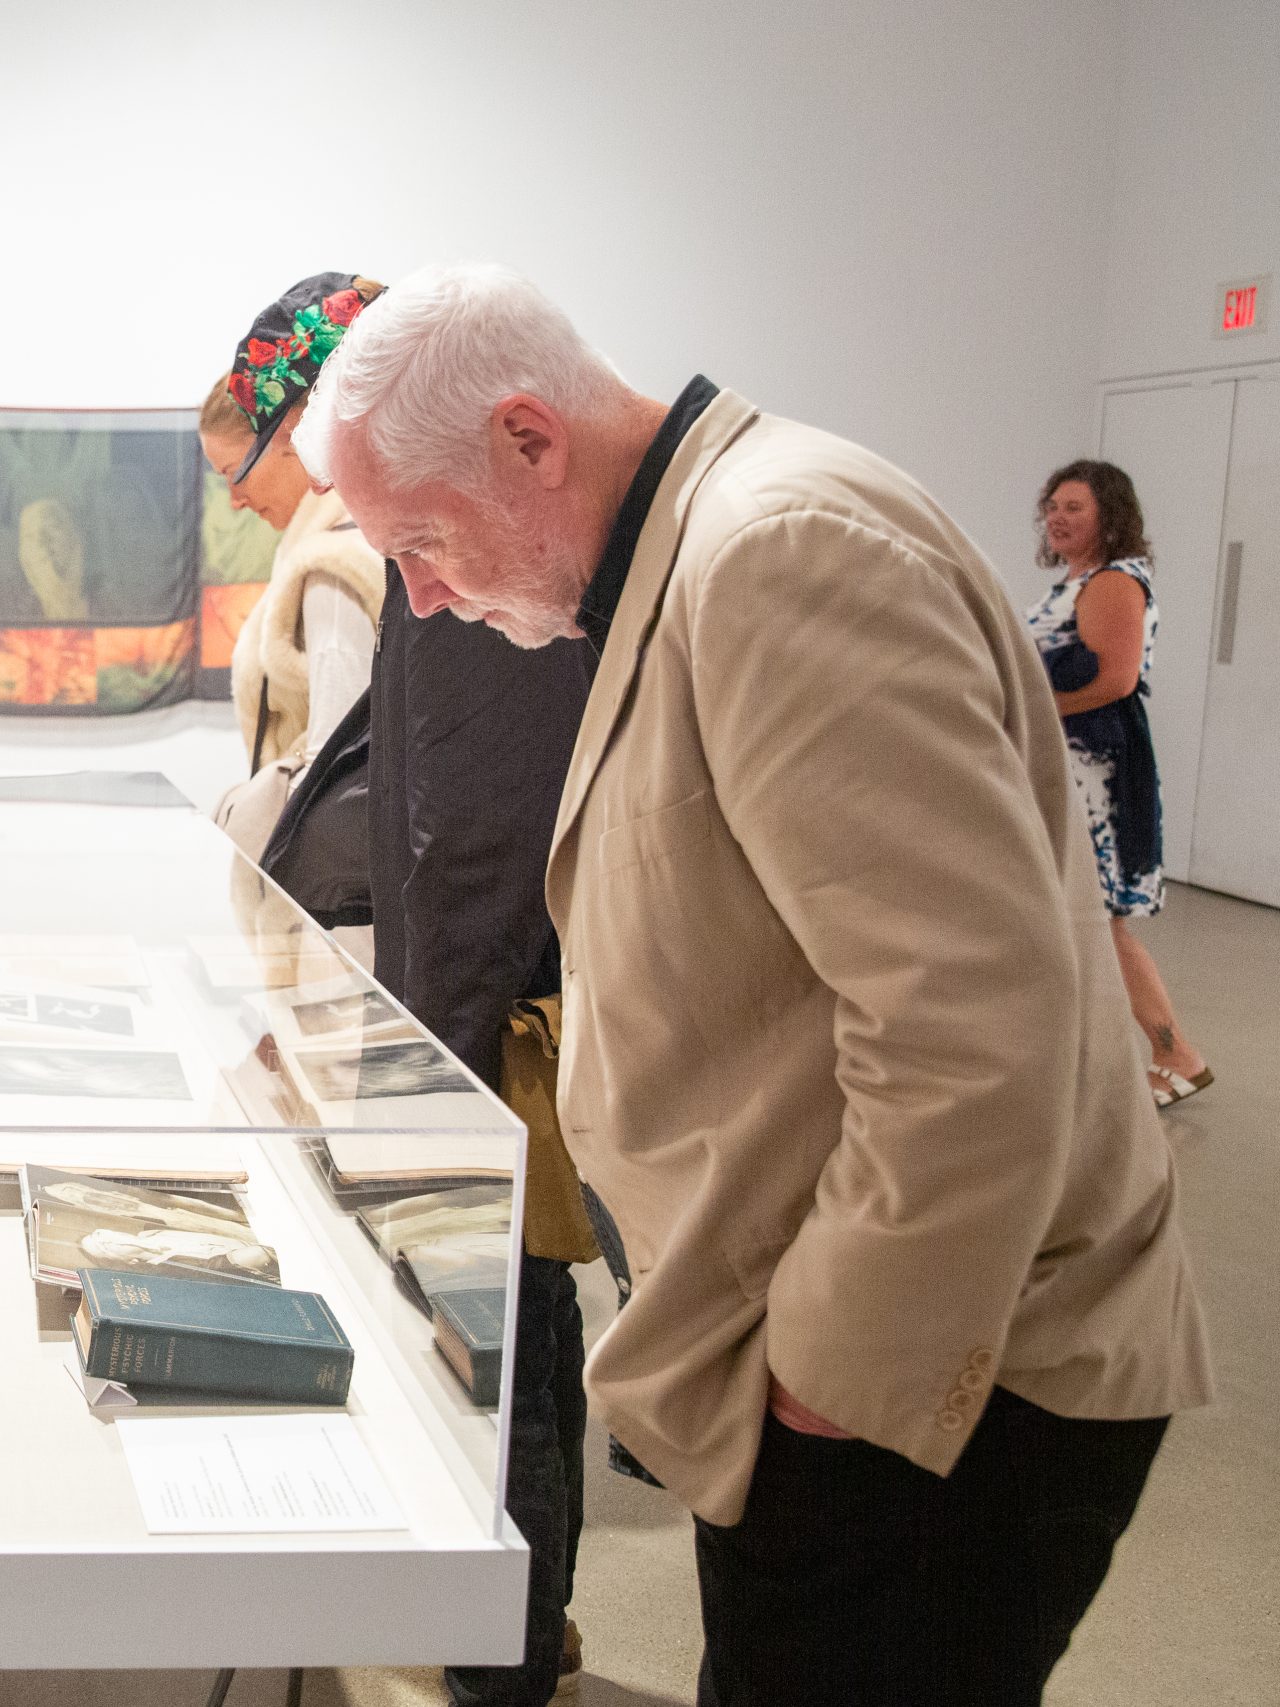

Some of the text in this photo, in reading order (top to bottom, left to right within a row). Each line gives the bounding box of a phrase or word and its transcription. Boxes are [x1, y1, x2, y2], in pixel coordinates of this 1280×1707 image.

[1223, 287, 1258, 331] EXIT
[108, 1326, 122, 1378] MYSTERIOUS
[121, 1334, 135, 1375] PSYCHIC
[134, 1338, 147, 1375] FORCES
